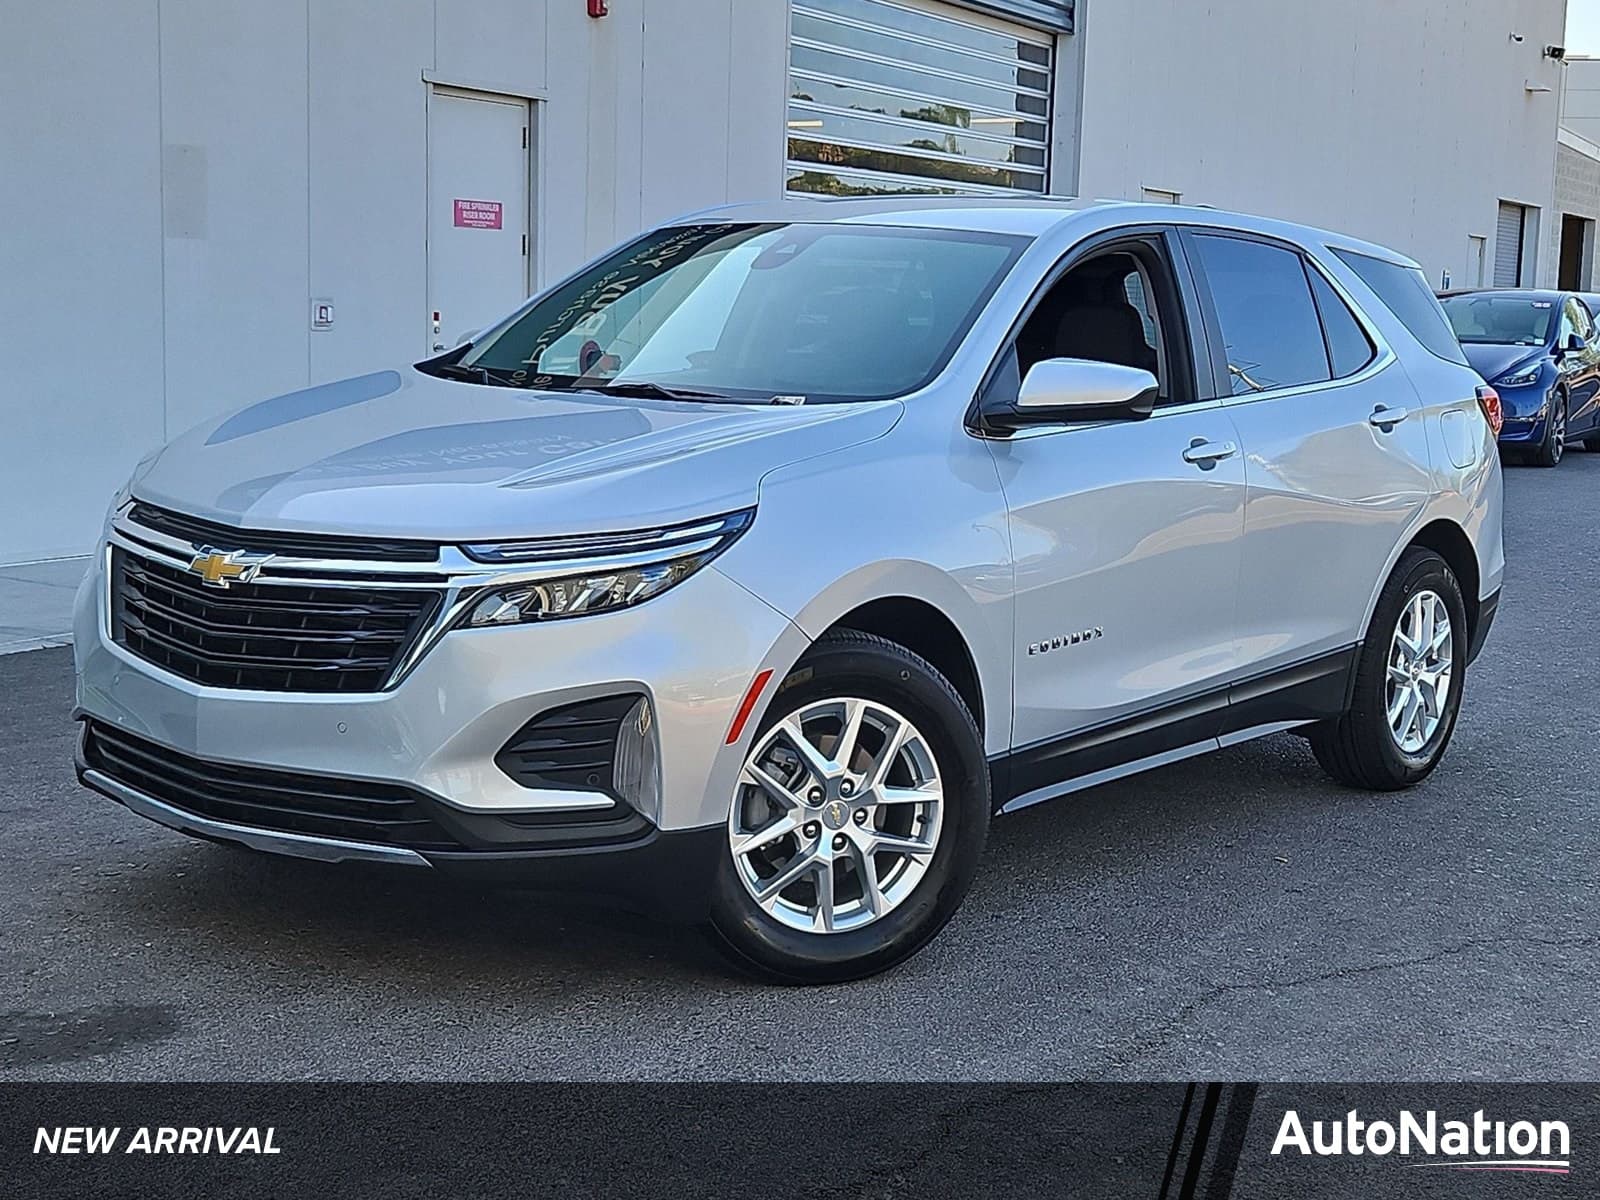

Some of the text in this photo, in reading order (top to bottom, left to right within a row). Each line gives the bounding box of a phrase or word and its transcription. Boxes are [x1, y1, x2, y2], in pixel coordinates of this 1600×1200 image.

[458, 201, 470, 209] FIRE
[479, 212, 496, 220] ROOM
[1028, 626, 1104, 656] EQUINOX
